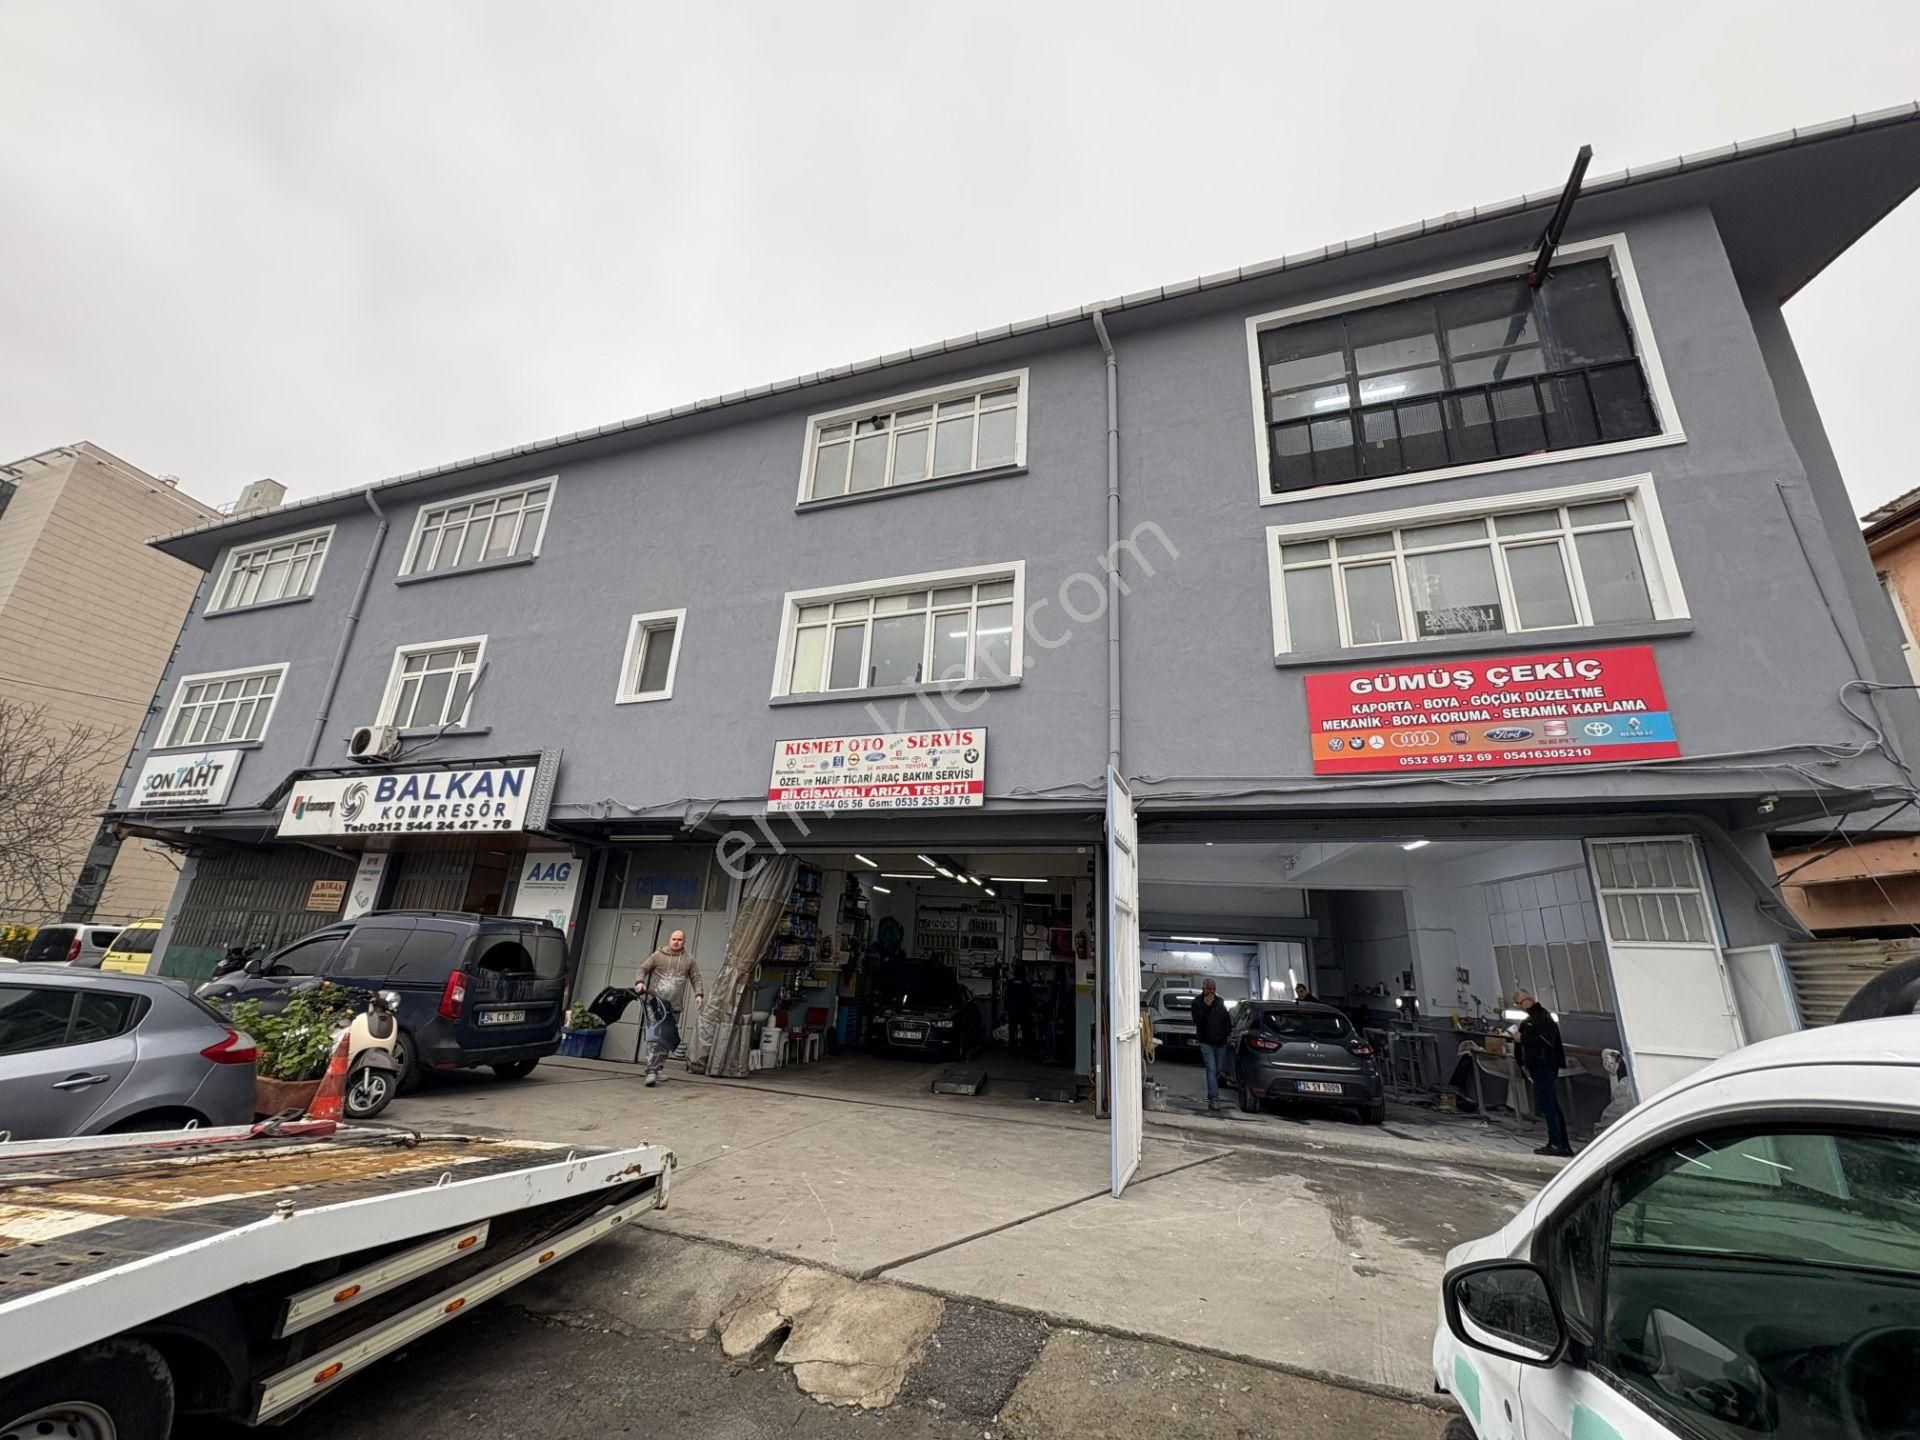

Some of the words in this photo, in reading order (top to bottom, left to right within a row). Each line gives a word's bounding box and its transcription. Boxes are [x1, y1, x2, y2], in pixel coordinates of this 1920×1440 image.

[1349, 668, 1475, 694] GÜMÜŞ
[1485, 656, 1602, 688] ÇEKİÇ
[1351, 700, 1412, 715] KAPORTA
[1423, 696, 1459, 710] BOYA
[1470, 691, 1522, 707] GÖÇÜK
[1525, 686, 1605, 703] DÜZELTME
[1322, 715, 1382, 731] MEKANİK
[1392, 714, 1428, 726] BOYA
[1430, 710, 1491, 725] KORUMA
[1502, 703, 1568, 719] SERAMİK
[1571, 699, 1647, 715] KAPLAMA
[785, 740, 844, 755] KISMET
[848, 737, 884, 752] OTO
[907, 730, 973, 749] SERVİS
[1400, 755, 1429, 766] 0532
[1432, 754, 1453, 764] 697
[1457, 754, 1474, 763] 52
[1476, 753, 1492, 762] 69
[1503, 748, 1592, 761] 05416305210
[374, 769, 525, 802] BALKAN
[780, 775, 801, 787] ÖZEL
[803, 778, 812, 786] ve
[815, 774, 840, 786] HAFİF
[843, 773, 872, 784] TİCARİ
[874, 772, 900, 784] ARAÇ
[902, 771, 933, 782] BAKIM
[935, 767, 973, 780] SERVİSİ
[781, 787, 866, 800] BİLGİSAYARLI
[869, 785, 910, 797] ARIZA
[914, 782, 968, 796] TESPİTİ
[381, 799, 506, 819] KOMPRESÖR
[776, 801, 792, 811] Tel:
[794, 801, 816, 810] 0212
[818, 800, 835, 809] 544
[838, 800, 849, 808] 05
[852, 799, 863, 808] 56
[868, 798, 893, 807] Gsm:
[895, 797, 919, 807] 0535
[921, 796, 940, 806] 253
[943, 796, 955, 805] 38
[958, 795, 971, 805] 76
[343, 822, 402, 833] Tel:0212
[405, 821, 433, 831] 544
[436, 821, 455, 831] 24
[459, 820, 479, 830] 47
[493, 819, 512, 829] 78
[526, 862, 572, 882] AAG
